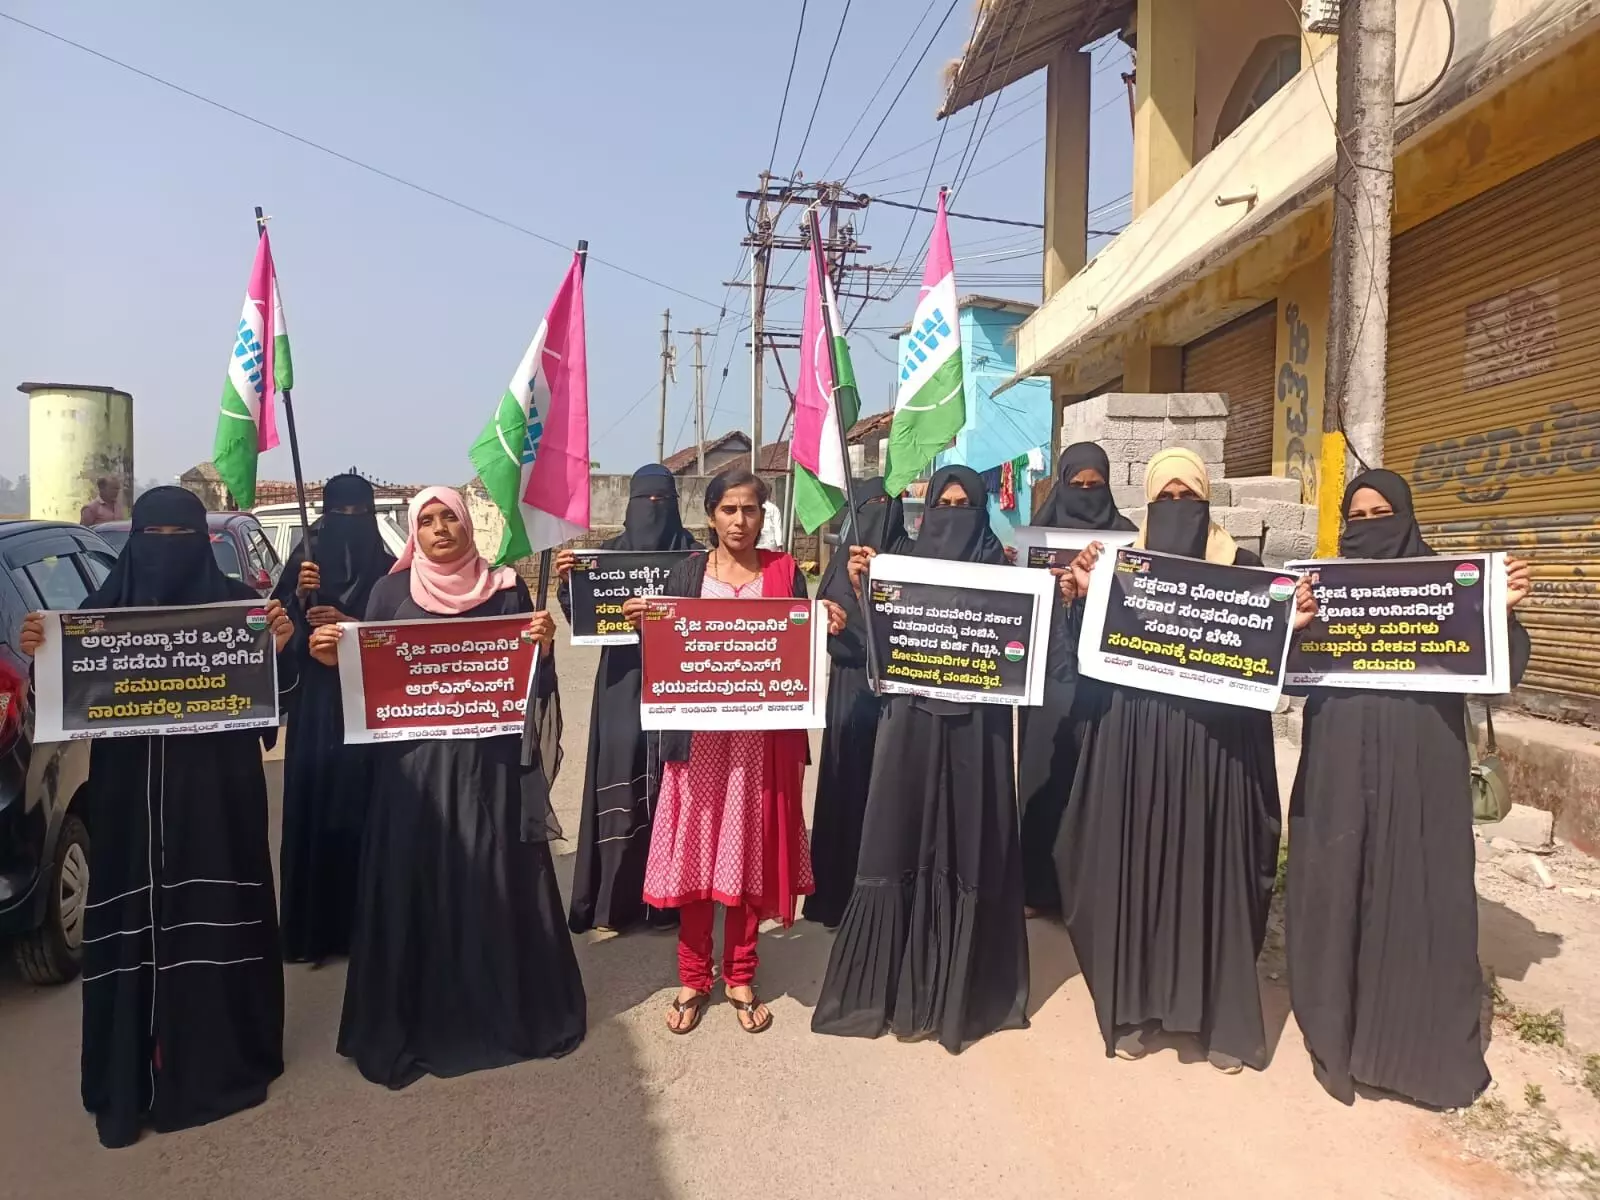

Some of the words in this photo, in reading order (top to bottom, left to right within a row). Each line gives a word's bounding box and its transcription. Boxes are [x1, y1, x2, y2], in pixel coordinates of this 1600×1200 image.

[588, 569, 625, 580] ಒಂದು
[629, 566, 660, 583] ಕಣ್ಣಿಗೆ
[593, 586, 630, 596] ಒಂದು
[1133, 576, 1187, 596] ಪಕ್ಷಪಾತಿ
[1190, 583, 1271, 608] ಧೋರಣೆಯ
[1313, 586, 1347, 603] ದ್ವೇಷ
[1350, 582, 1453, 600] ಭಾಷಣಕಾರರಿಗೆ
[875, 602, 923, 616] ಅಧಿಕಾರದ
[925, 607, 982, 621] ಮದವೇರಿದ
[984, 612, 1022, 625] ಸರ್ಕಾರ
[1123, 594, 1176, 614] ಸರಕಾರ
[1177, 603, 1273, 630] ಸಂಘದೊಂದಿಗೆ
[1368, 602, 1454, 620] ಉನಿಸದಿದ್ದರೆ
[674, 616, 701, 637] ನೈಜ
[705, 618, 787, 634] ಸಾಂವಿಧಾನಿಕ
[893, 619, 958, 639] ಮತದಾರರನ್ನು
[1144, 618, 1203, 642] ಸಂಬಂಧ
[1205, 628, 1242, 647] ಬೆಳೆಸಿ
[1328, 622, 1375, 639] ಮಕ್ಕಳು
[1379, 621, 1439, 634] ಮರಿಗಳು
[81, 629, 197, 653] ಅಲ್ಪಸಂಖ್ಯಾತರ
[396, 642, 426, 661] ನೈಜ
[430, 637, 519, 654] ಸಾಂವಿಧಾನಿಕ
[685, 637, 777, 651] ಸರ್ಕಾರವಾದರೆ
[889, 634, 938, 648] ಅಧಿಕಾರದ
[1107, 633, 1186, 664] ಸಂವಿಧಾನಕ್ಕೆ
[1302, 640, 1367, 657] ಹುಟ್ಟುವರು
[1371, 639, 1416, 652] ದೇಶವ
[1420, 640, 1470, 652] ಮುಗಿಸಿ
[72, 656, 107, 672] ಮತ
[112, 653, 167, 670] ಪಡೆದು
[172, 651, 210, 672] ಗೆದ್ದು
[211, 649, 263, 666] ಬೀಗಿದ
[410, 656, 509, 674] ಸರ್ಕಾರವಾದರೆ
[892, 648, 970, 667] ಕೋಮುವಾದಿಗಳ
[971, 658, 996, 673] ರಕ್ಷಿಸಿ
[1353, 658, 1415, 671] ಬಿಡುವರು
[114, 673, 226, 693] ಸಮುದಾಯದ
[886, 664, 942, 684] ಸಂವಿಧಾನಕ್ಕೆ
[652, 679, 766, 697] ಭಯಪಡುವುದನ್ನು
[768, 678, 807, 696] ನಿಲ್ಲಿಸಿ.
[88, 698, 184, 720] ನಾಯಕರೆಲ್ಲ
[186, 694, 251, 716] ನಾಪತ್ತೆ?!
[376, 699, 499, 721] ಭಯಪಡುವುದನ್ನು
